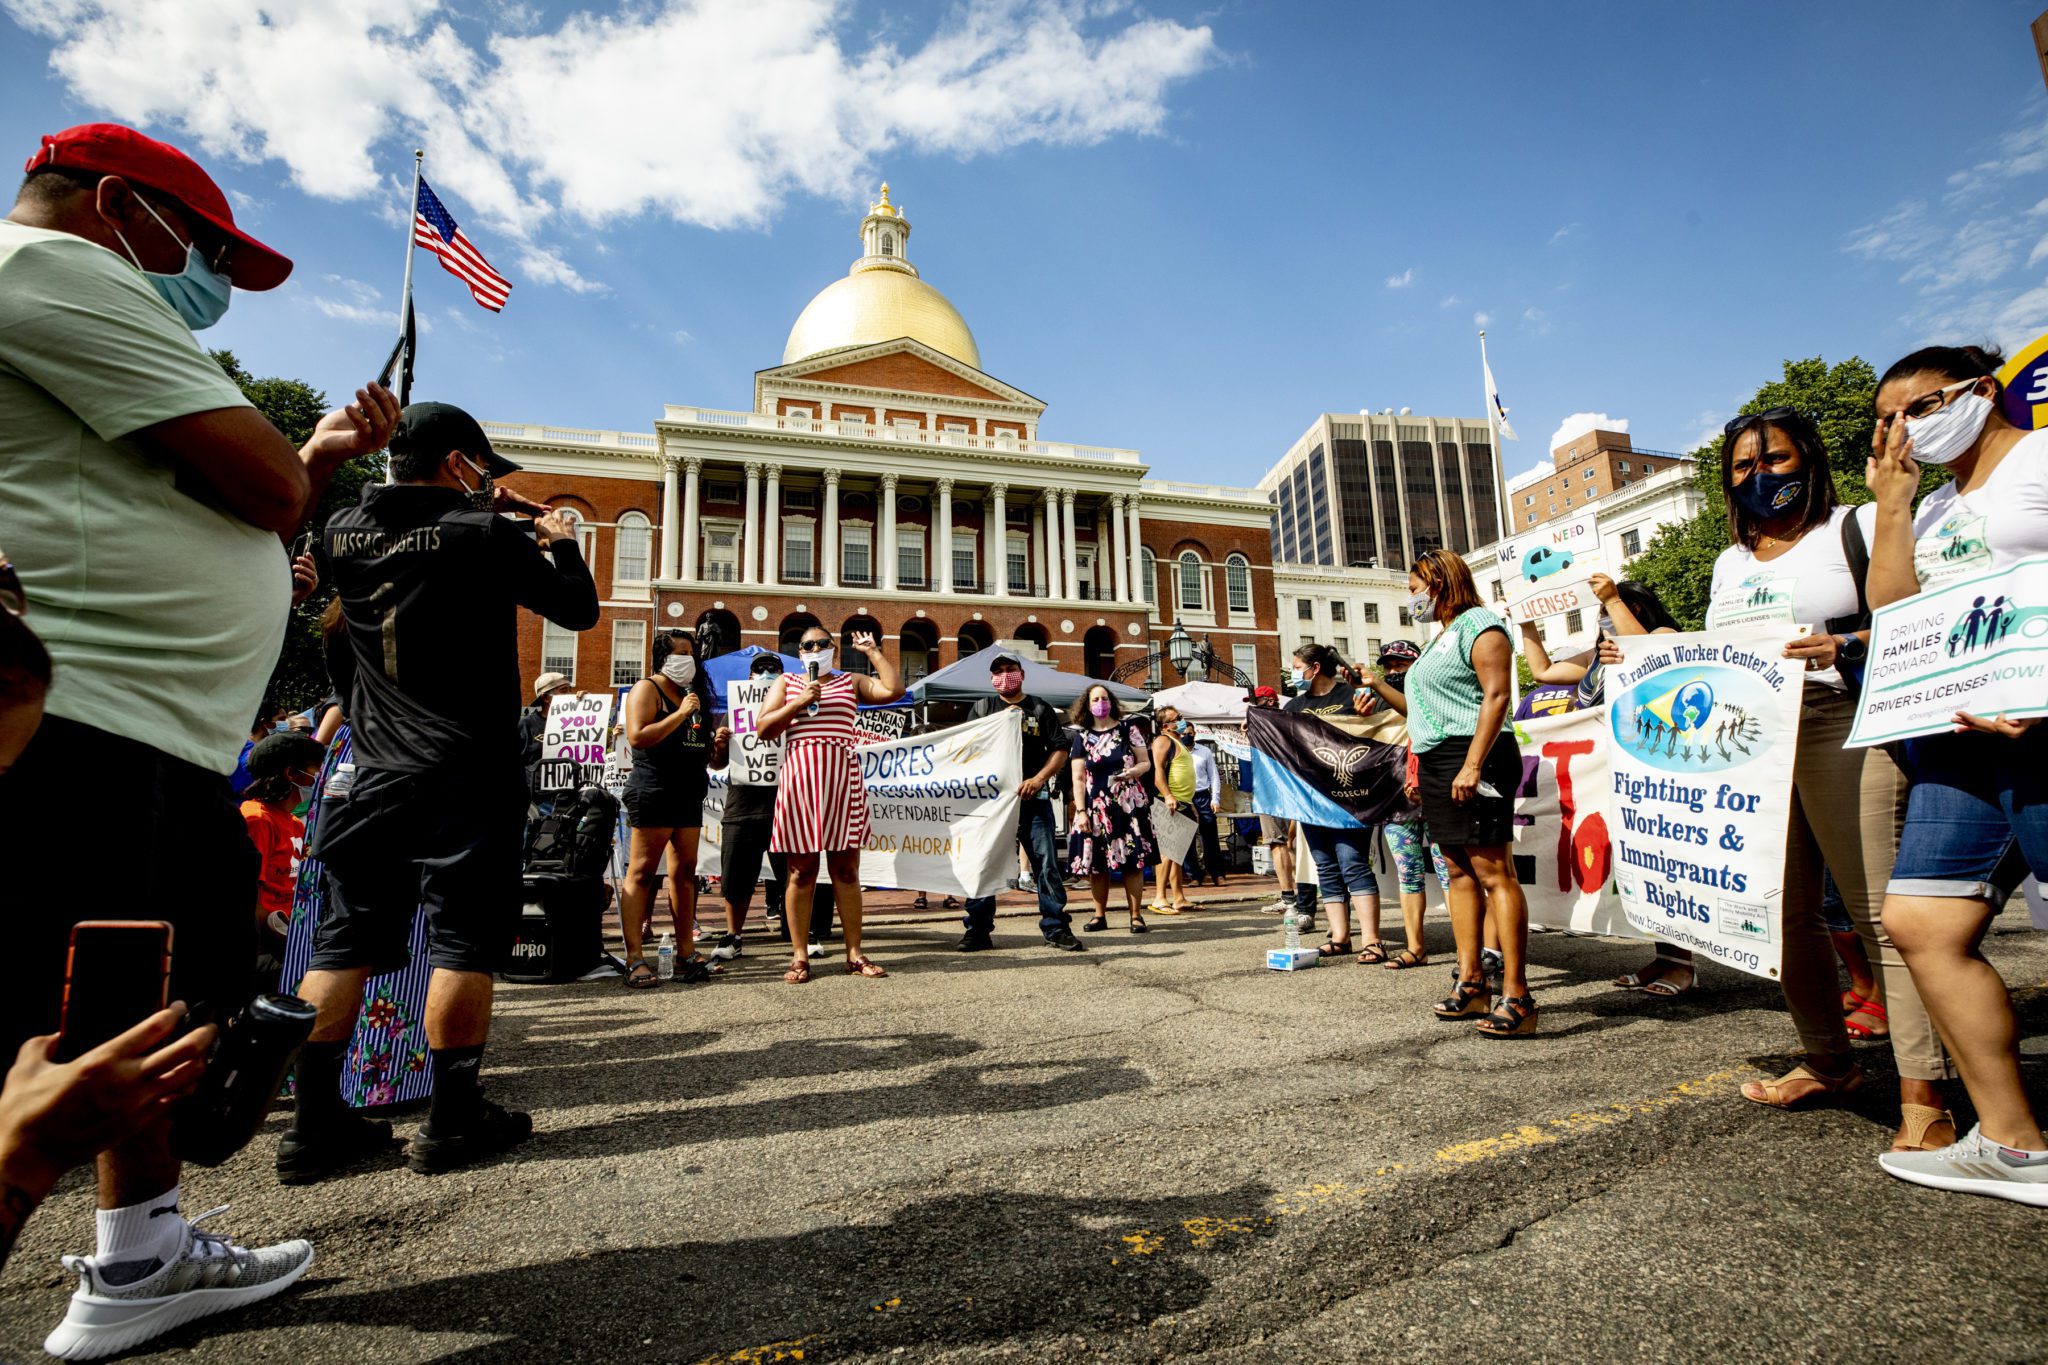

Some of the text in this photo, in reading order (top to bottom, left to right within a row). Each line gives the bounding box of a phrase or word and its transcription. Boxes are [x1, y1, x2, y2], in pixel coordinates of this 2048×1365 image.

[1499, 524, 1584, 562] WE NEED
[1521, 590, 1579, 619] LICENSES
[1716, 618, 1741, 628] DRIVER'S
[1741, 614, 1770, 623] LICENSES
[1890, 613, 1945, 641] DRIVING
[1882, 632, 1942, 660] FAMILIES
[1617, 644, 1785, 692] Brazilian Worker Center Inc.
[1871, 651, 1938, 680] FORWARD
[737, 684, 771, 704] WHA
[1532, 690, 1571, 703] 32B
[1868, 664, 2045, 715] DRIVER'S LICENSES NOW!
[550, 699, 603, 716] HOW DO
[560, 714, 597, 730] YOU
[733, 708, 758, 735] EL
[855, 718, 899, 740] AHORA
[547, 727, 604, 746] DENY
[742, 734, 782, 751] CAN
[557, 744, 605, 764] OUR
[745, 753, 778, 769] WE
[748, 769, 776, 783] DO
[1331, 788, 1369, 798] COSECHA
[1614, 771, 1761, 814] Fighting for
[873, 803, 951, 822] EXPENDABLE
[1620, 807, 1744, 852] Workers &
[1619, 840, 1748, 893] Immigrants
[1644, 880, 1710, 924] Rights
[1627, 910, 1759, 969] www.braziliancenter.org
